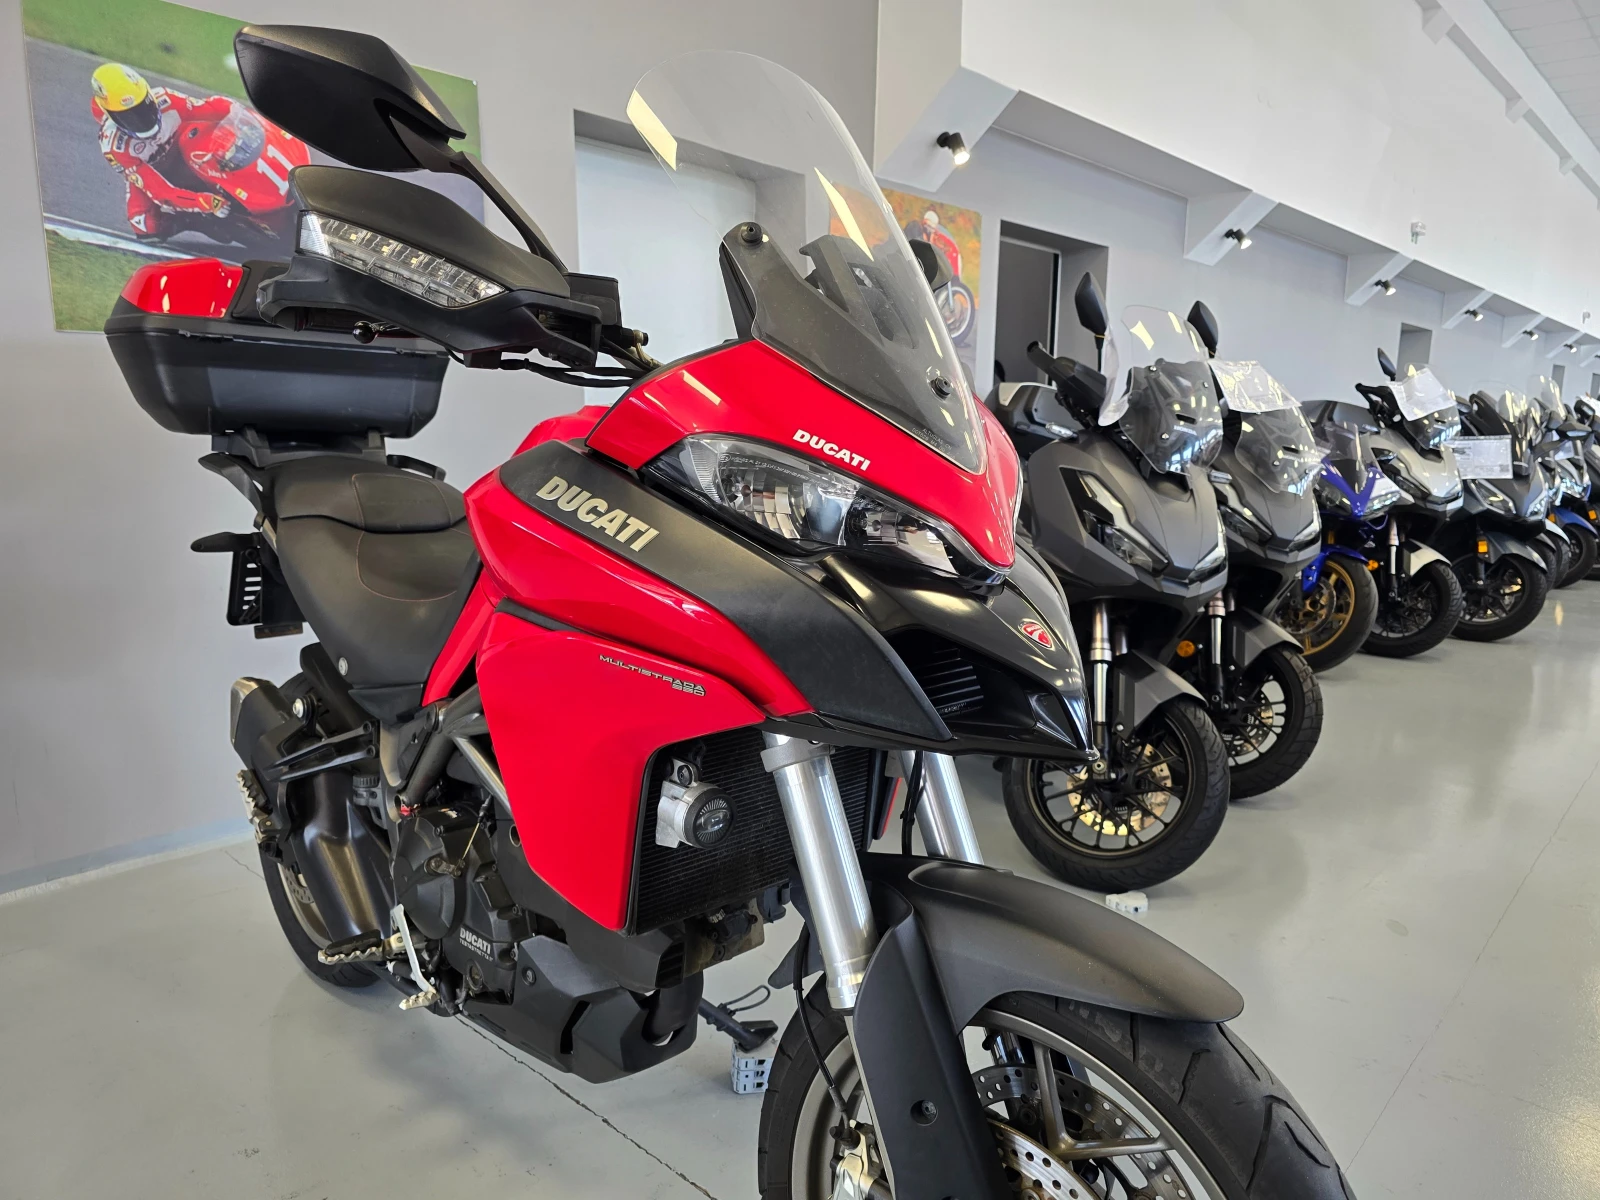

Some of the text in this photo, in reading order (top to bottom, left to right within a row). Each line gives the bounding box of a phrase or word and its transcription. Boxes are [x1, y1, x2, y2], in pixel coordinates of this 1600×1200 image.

[257, 144, 295, 196] 11
[792, 429, 871, 471] DUCATI
[1173, 424, 1198, 436] HONDA
[535, 475, 660, 553] DUCATI
[599, 654, 705, 692] MULTISTRADA
[459, 927, 492, 955] DUCATI
